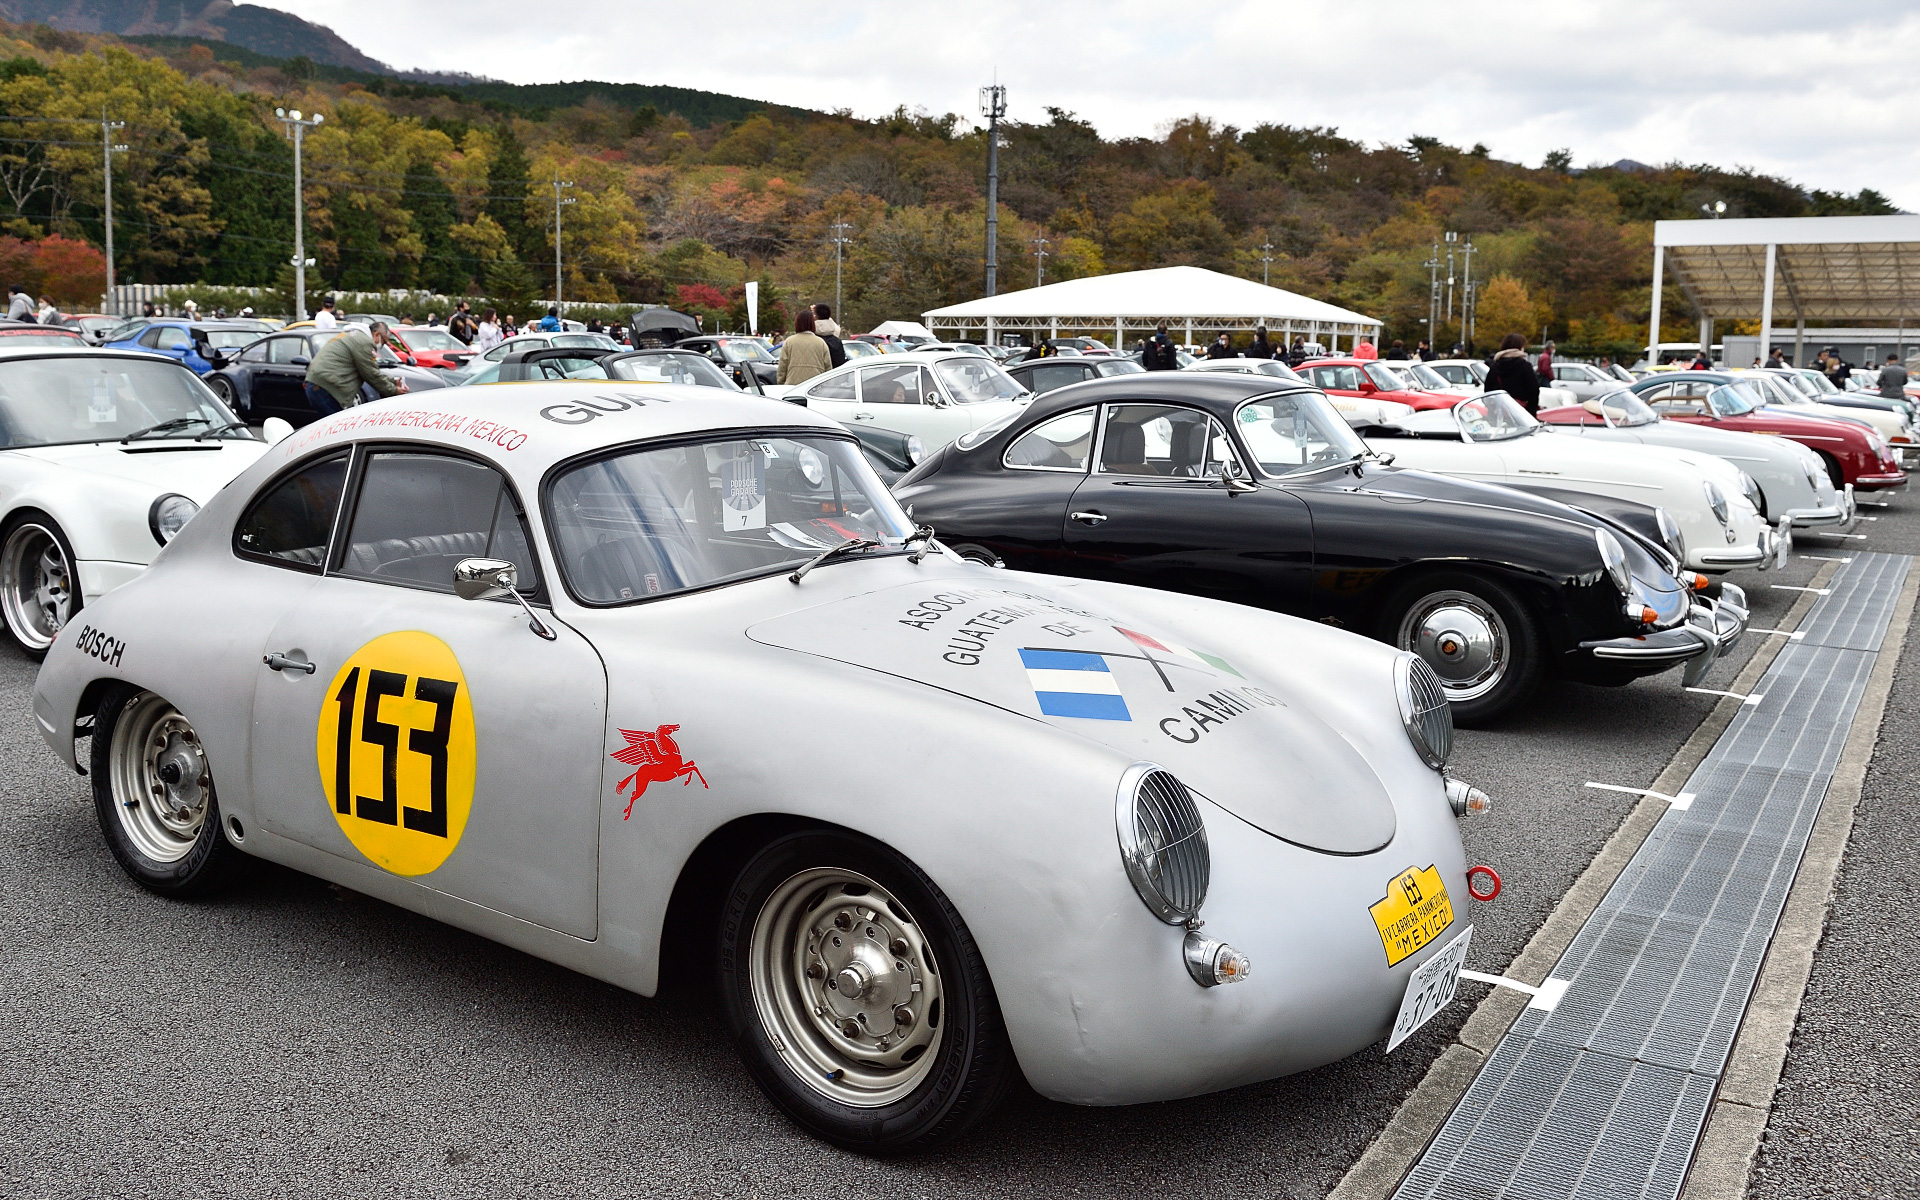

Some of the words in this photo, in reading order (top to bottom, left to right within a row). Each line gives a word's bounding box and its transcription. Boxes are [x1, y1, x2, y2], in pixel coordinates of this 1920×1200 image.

[539, 392, 671, 425] GUA
[358, 410, 469, 433] PANAMERICANA
[461, 416, 528, 452] MEXICO
[730, 478, 758, 488] PORSCHE
[730, 487, 758, 497] GARAGE
[741, 515, 748, 526] 7
[1040, 620, 1094, 638] DE
[75, 624, 126, 668] BOSCH
[335, 666, 459, 839] 153
[1399, 873, 1424, 907] 153
[1382, 926, 1394, 943] IV
[1391, 910, 1420, 938] CARRERA
[1405, 961, 1460, 1034] 37-08
[934, 1026, 965, 1104] ENERGY
